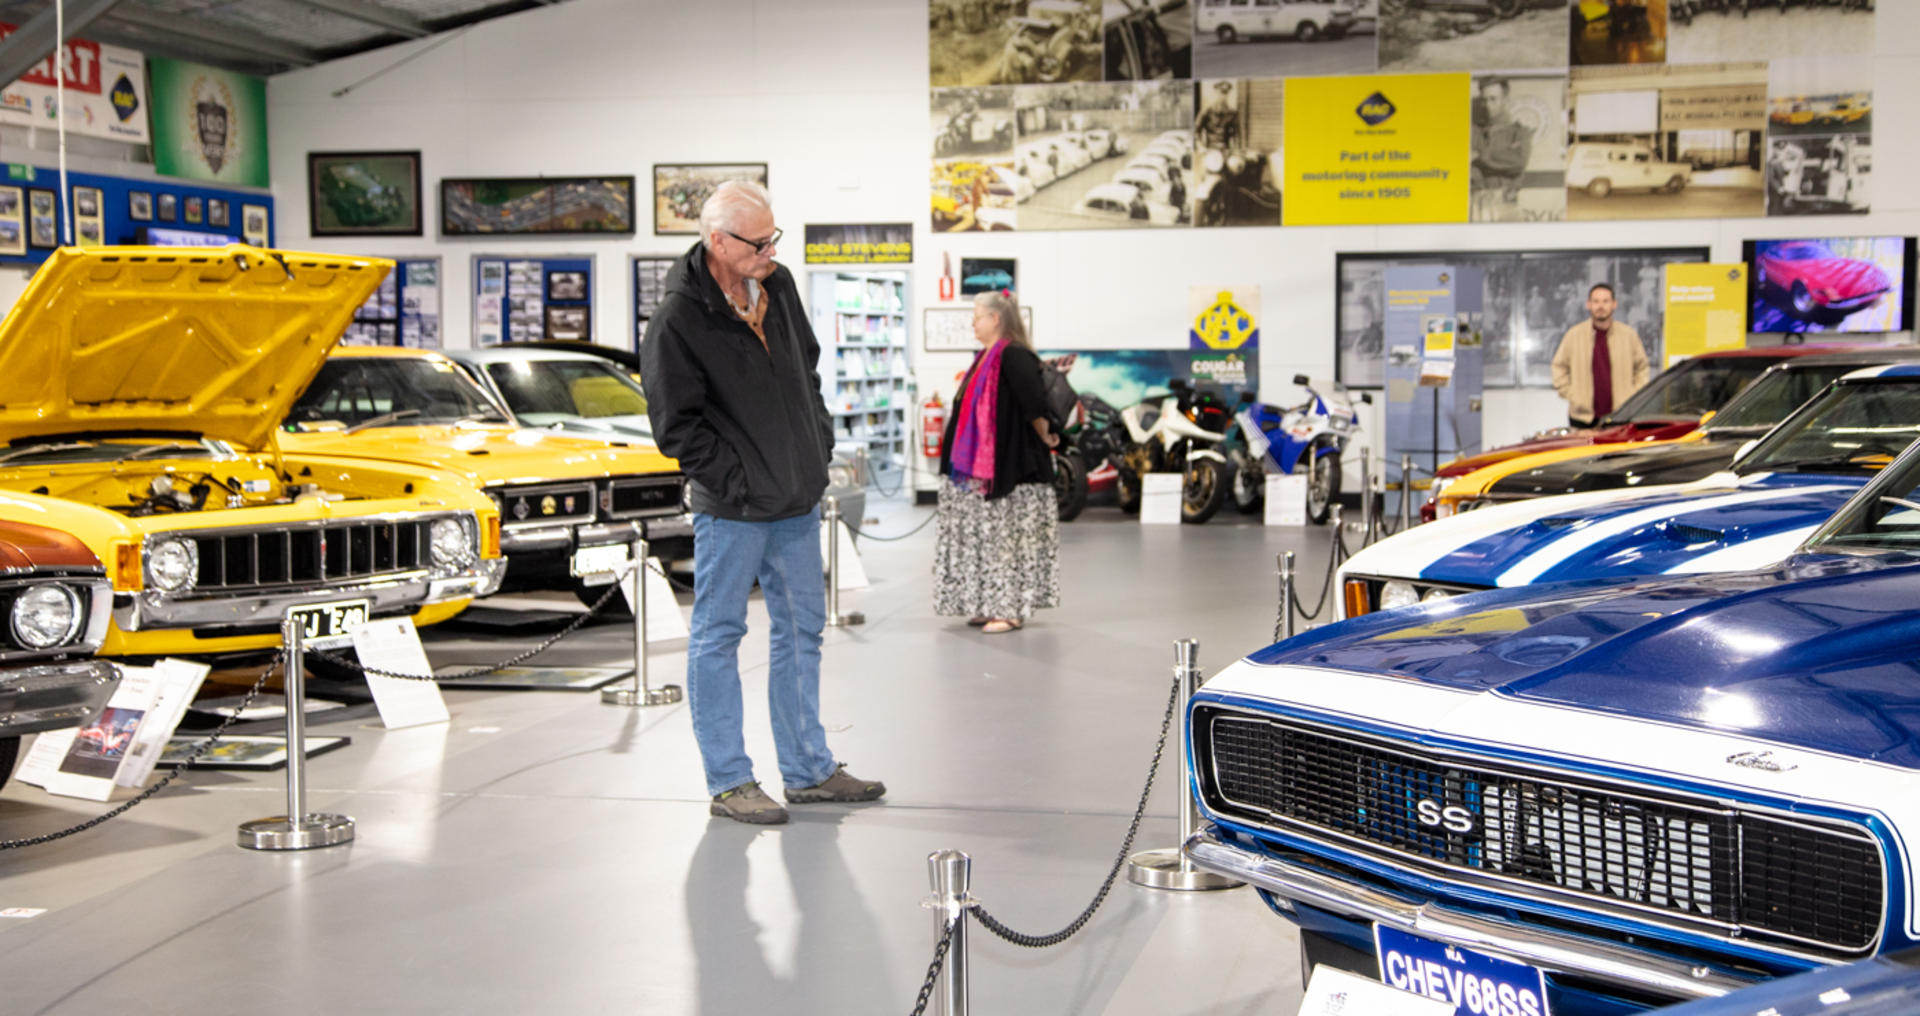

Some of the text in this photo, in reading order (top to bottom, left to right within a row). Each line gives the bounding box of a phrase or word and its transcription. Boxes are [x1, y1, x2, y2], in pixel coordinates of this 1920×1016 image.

[1361, 103, 1391, 117] RAC
[1340, 149, 1411, 162] Part of the
[1302, 167, 1450, 183] motoring community
[1339, 186, 1411, 199] since 1905
[806, 242, 911, 254] DON STEVENS
[1192, 359, 1246, 374] COUGAR
[1417, 798, 1473, 833] SS
[1386, 950, 1544, 1016] CHEV68SS
